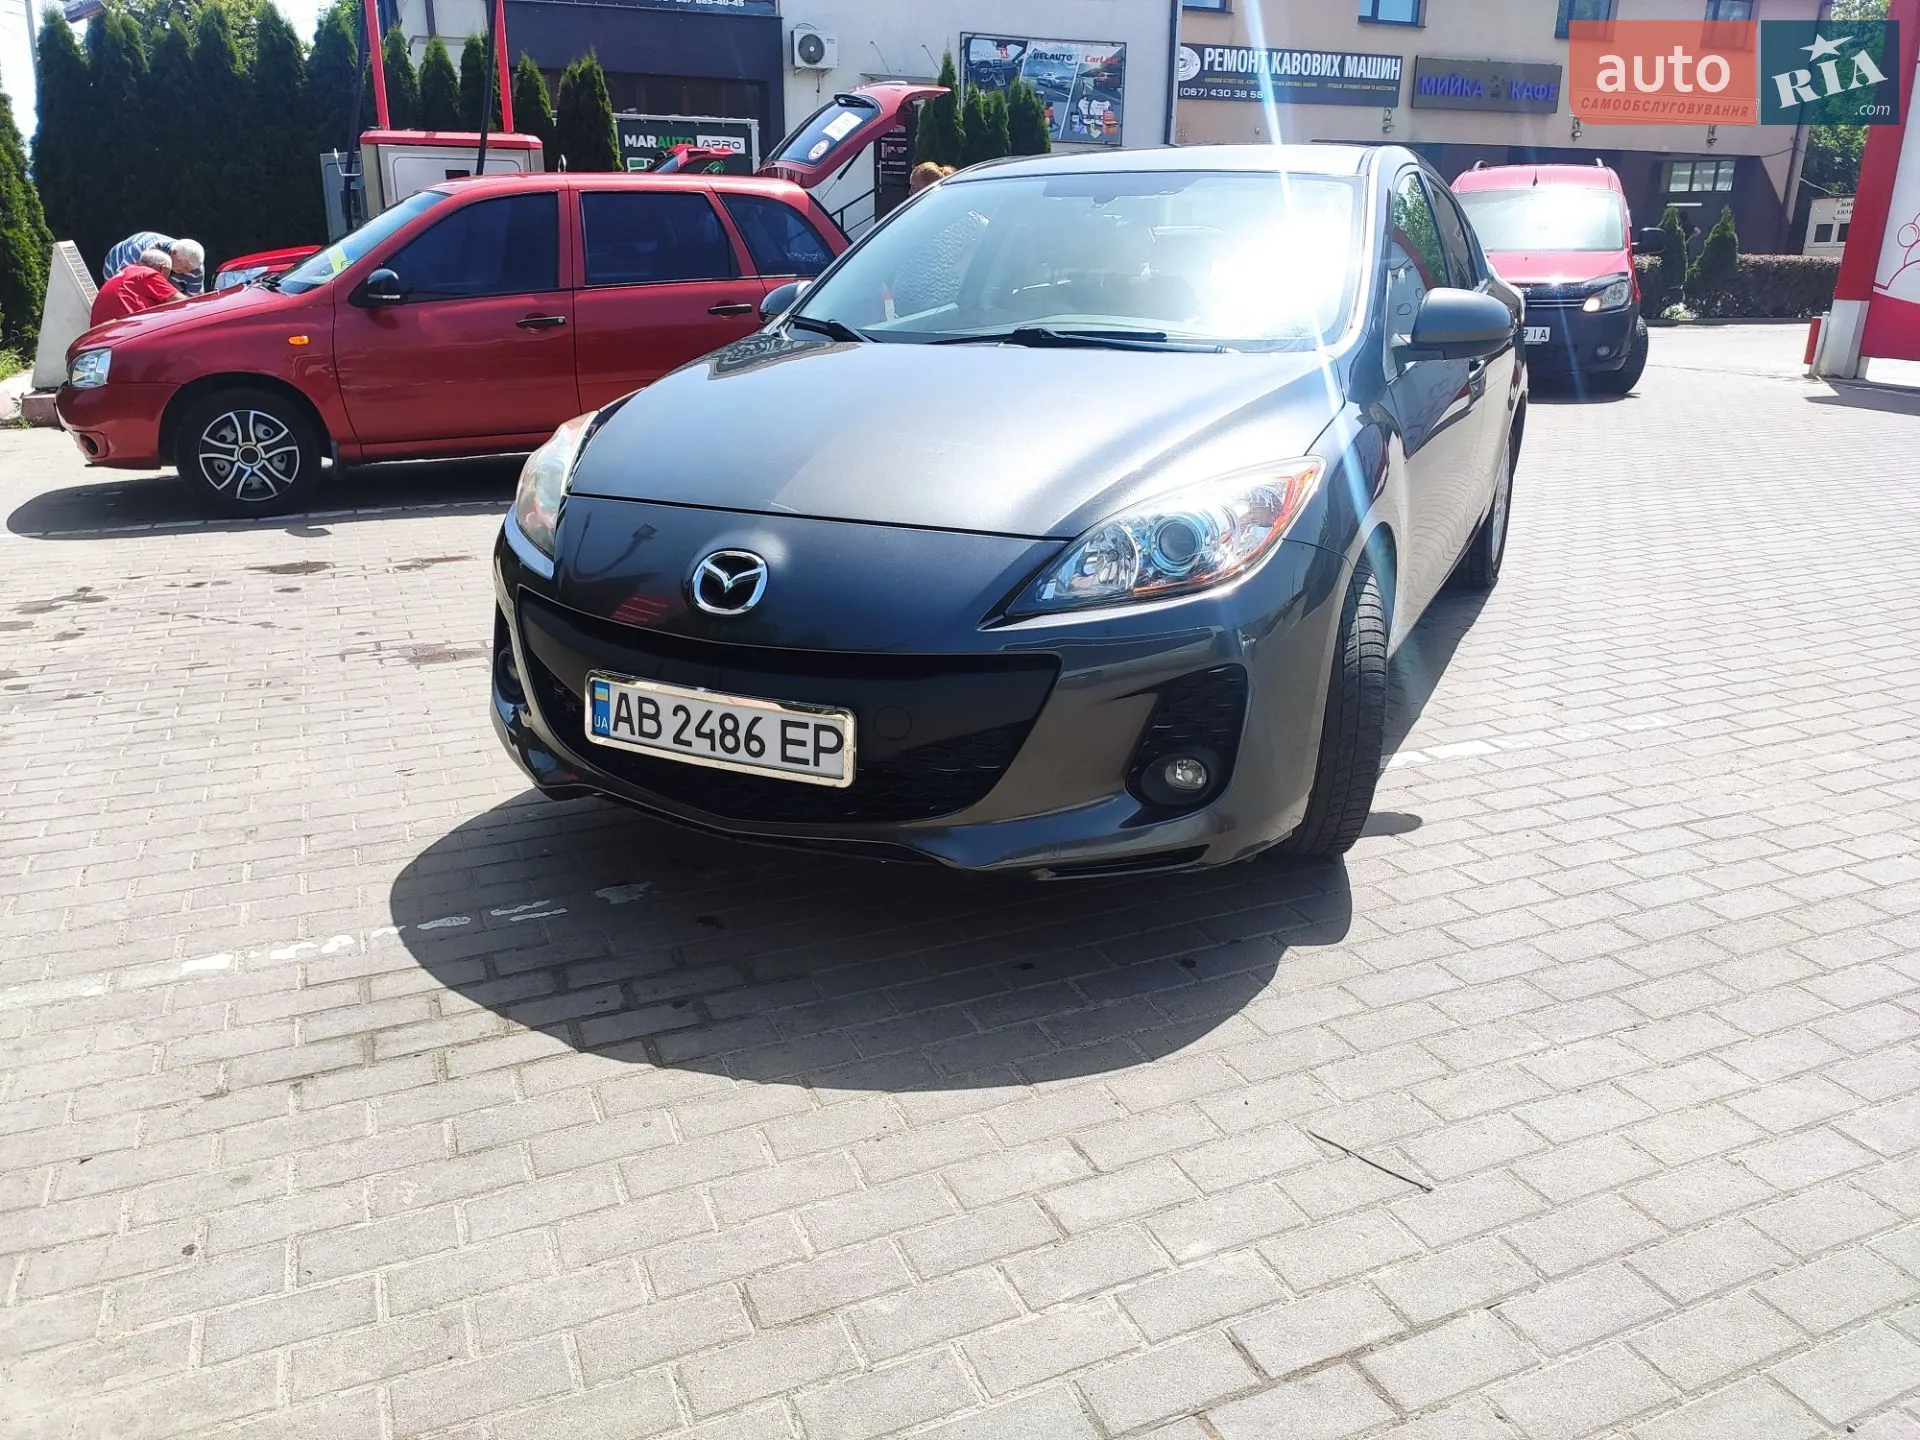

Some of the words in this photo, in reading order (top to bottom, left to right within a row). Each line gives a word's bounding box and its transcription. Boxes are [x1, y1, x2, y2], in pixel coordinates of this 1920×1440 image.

[1033, 52, 1073, 62] BELAUTO
[1203, 47, 1268, 74] РЕМОНТ
[1271, 51, 1341, 78] КАВОВИХ
[1343, 55, 1402, 81] МАШИН
[1180, 87, 1208, 98] (067)
[1210, 88, 1231, 98] 430
[1233, 89, 1247, 99] 38
[1420, 73, 1485, 98] МИЙКА
[1510, 79, 1558, 103] КАФЕ
[1580, 96, 1749, 118] САМООБСЛУГОВУВАННЯ
[594, 715, 609, 730] UA
[612, 692, 662, 740] AB
[672, 704, 766, 758] 2486
[780, 719, 844, 767] EP
